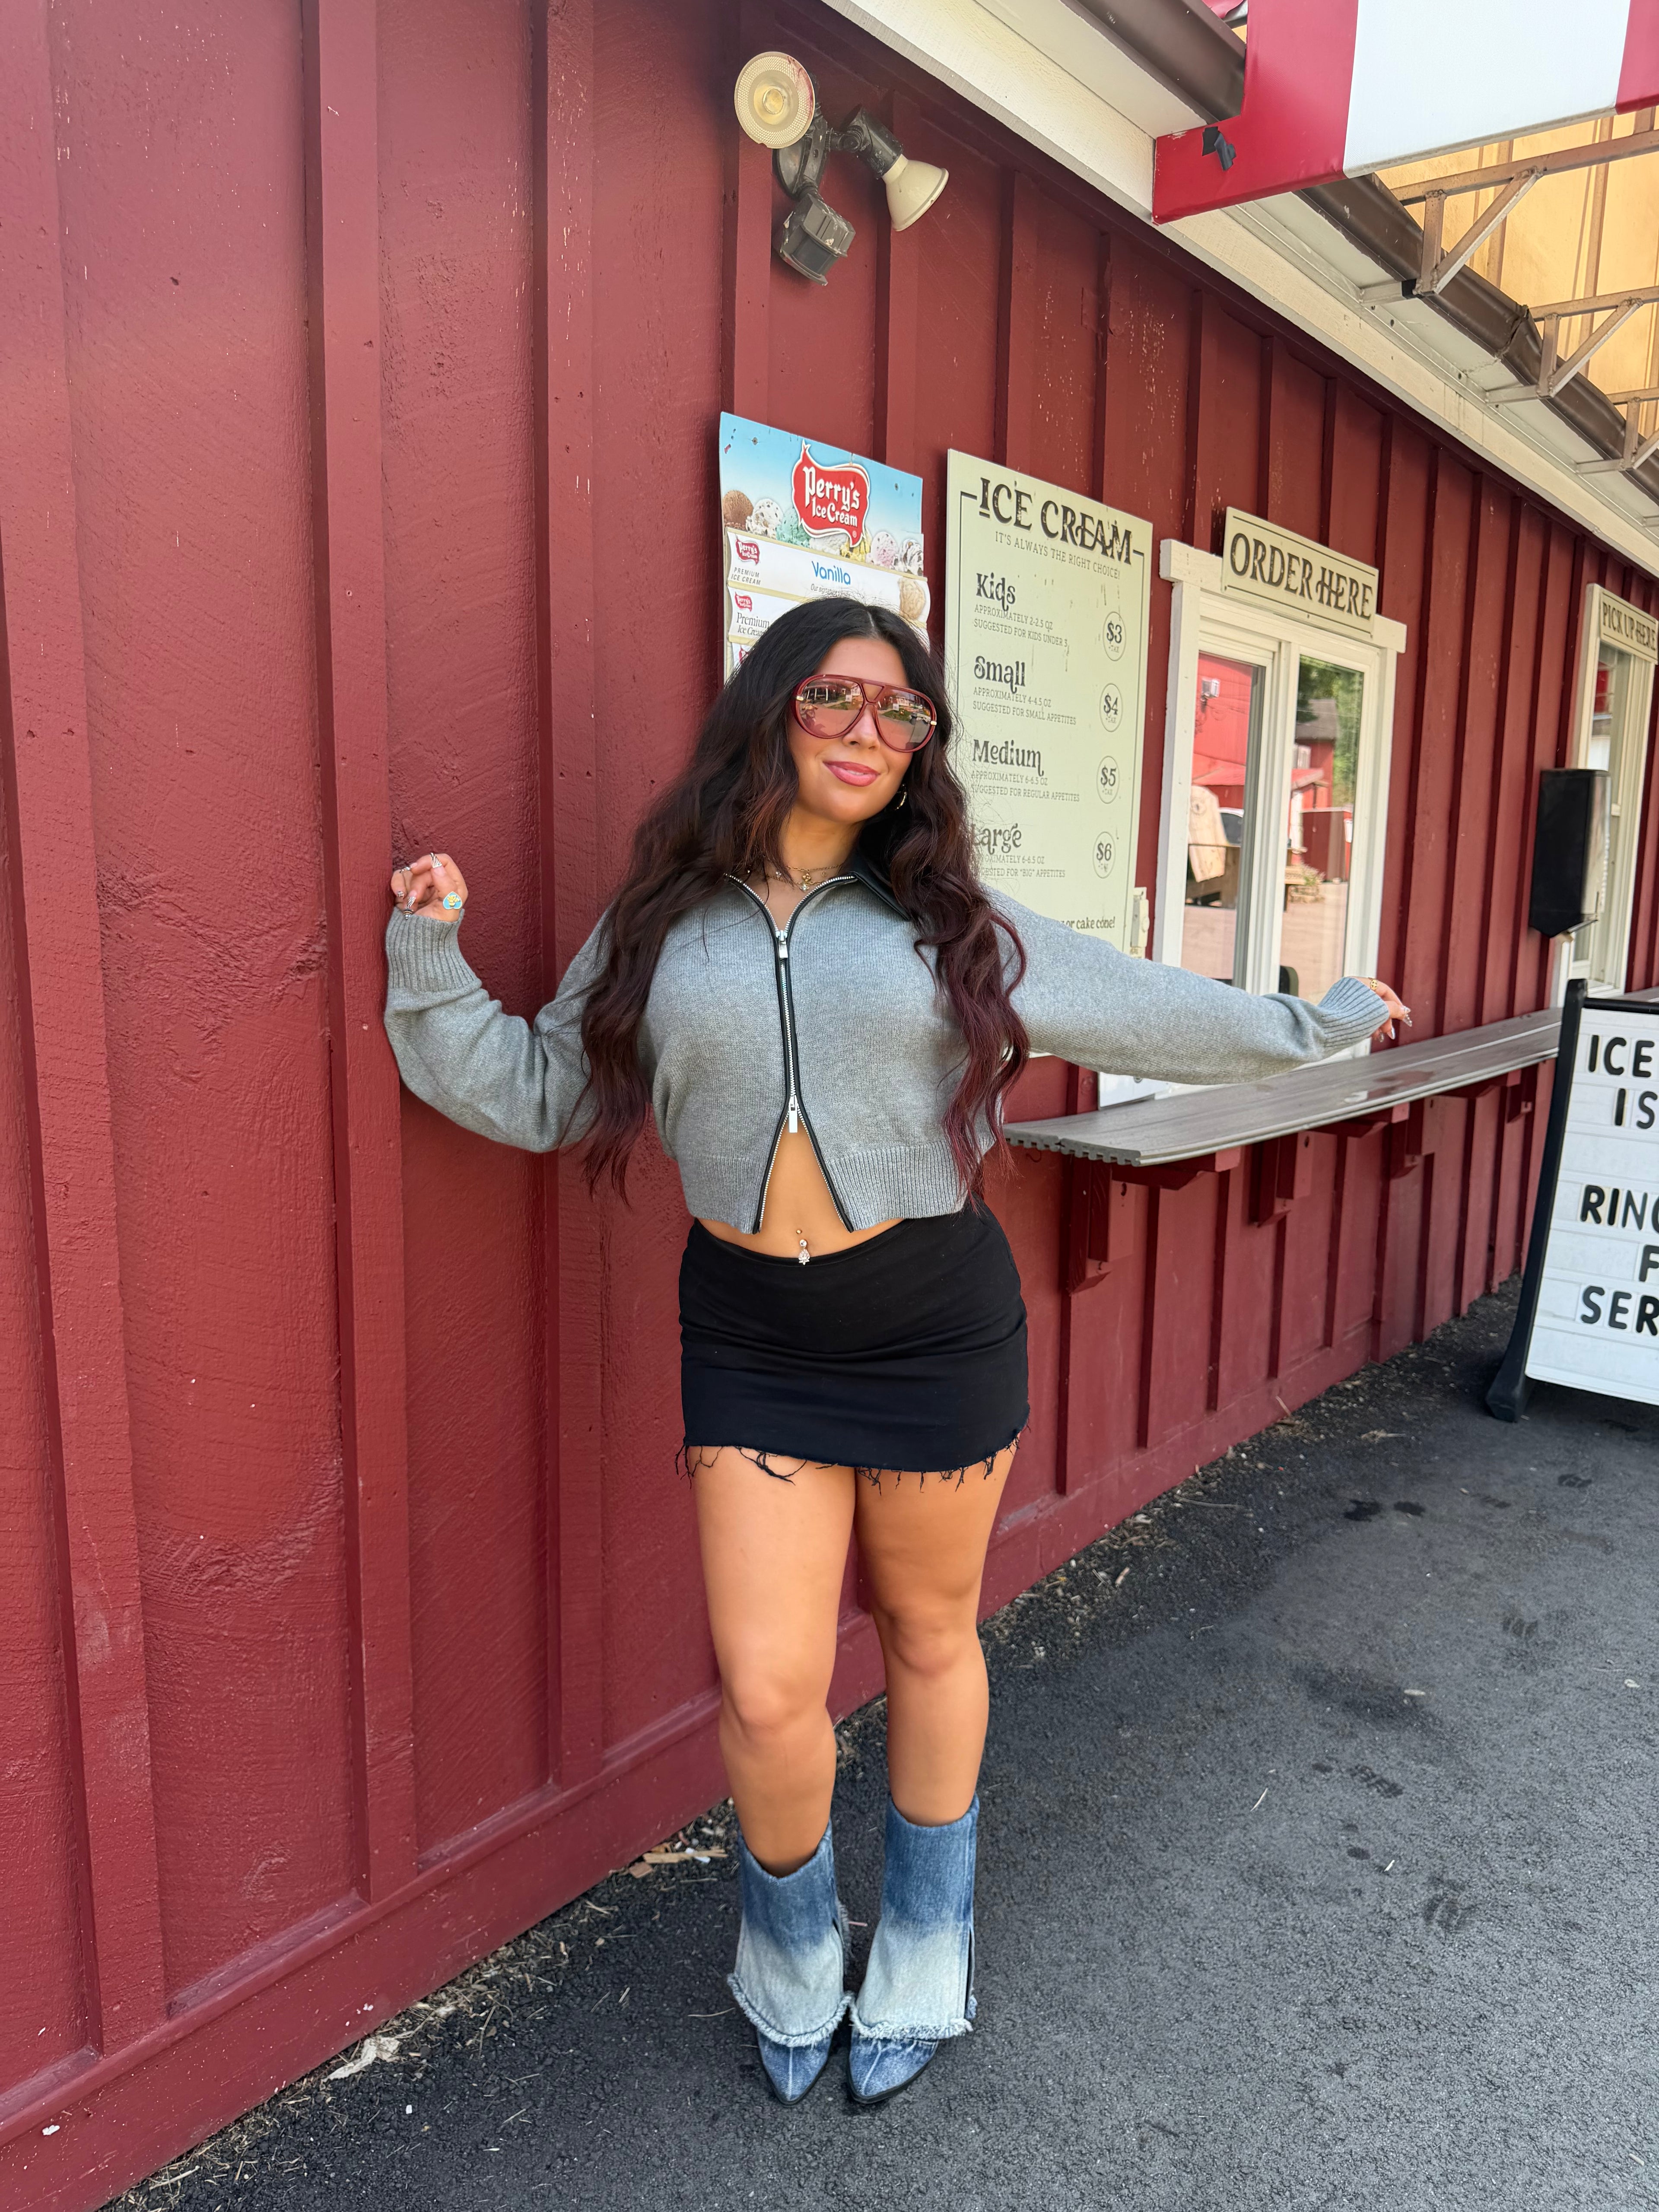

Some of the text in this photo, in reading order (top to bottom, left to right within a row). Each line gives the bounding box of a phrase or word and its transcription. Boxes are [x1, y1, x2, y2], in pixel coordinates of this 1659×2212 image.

[803, 466, 860, 512] Perry's
[979, 477, 1131, 565] ICE CREAM
[995, 531, 1120, 579] IT'S ALWAYS THE RIGHT CHOICE!
[734, 567, 760, 577] PREMIUM
[742, 576, 761, 585] CREAM
[812, 561, 851, 585] Vanilla
[1230, 533, 1373, 621] ORDER HERE
[976, 572, 1016, 611] Kids
[737, 612, 769, 629] Premium
[975, 604, 1029, 623] APPROXIMATELY
[737, 625, 746, 634] Ice
[974, 619, 1012, 635] SUGGESTED
[1014, 627, 1026, 638] FOR
[1028, 630, 1042, 642] KIDS
[1043, 634, 1063, 646] UNDER
[1106, 621, 1122, 644] $3
[1603, 602, 1656, 651] PICK UP HERE
[974, 656, 1025, 694] Small
[973, 687, 1027, 703] APPROXIMATELY
[1043, 699, 1052, 708] OZ
[1104, 693, 1118, 716] $4
[973, 701, 1076, 725] SUGGESTED FOR SMALL APPETITES
[973, 739, 1044, 776] Medium
[971, 770, 1024, 783] APPROXIMATELY
[1040, 777, 1048, 786] OZ
[1100, 765, 1116, 787] $5
[1010, 788, 1021, 797] FOR
[1023, 789, 1050, 799] REGULAR
[1051, 792, 1080, 802] APPETITES
[1096, 841, 1112, 863] $6
[1007, 868, 1018, 877] FOR
[1036, 869, 1065, 877] APPETITES
[1066, 916, 1116, 929] or cake cone!
[1588, 1035, 1655, 1077] ICE
[1615, 1088, 1658, 1129] IS
[1580, 1285, 1659, 1336] SER
